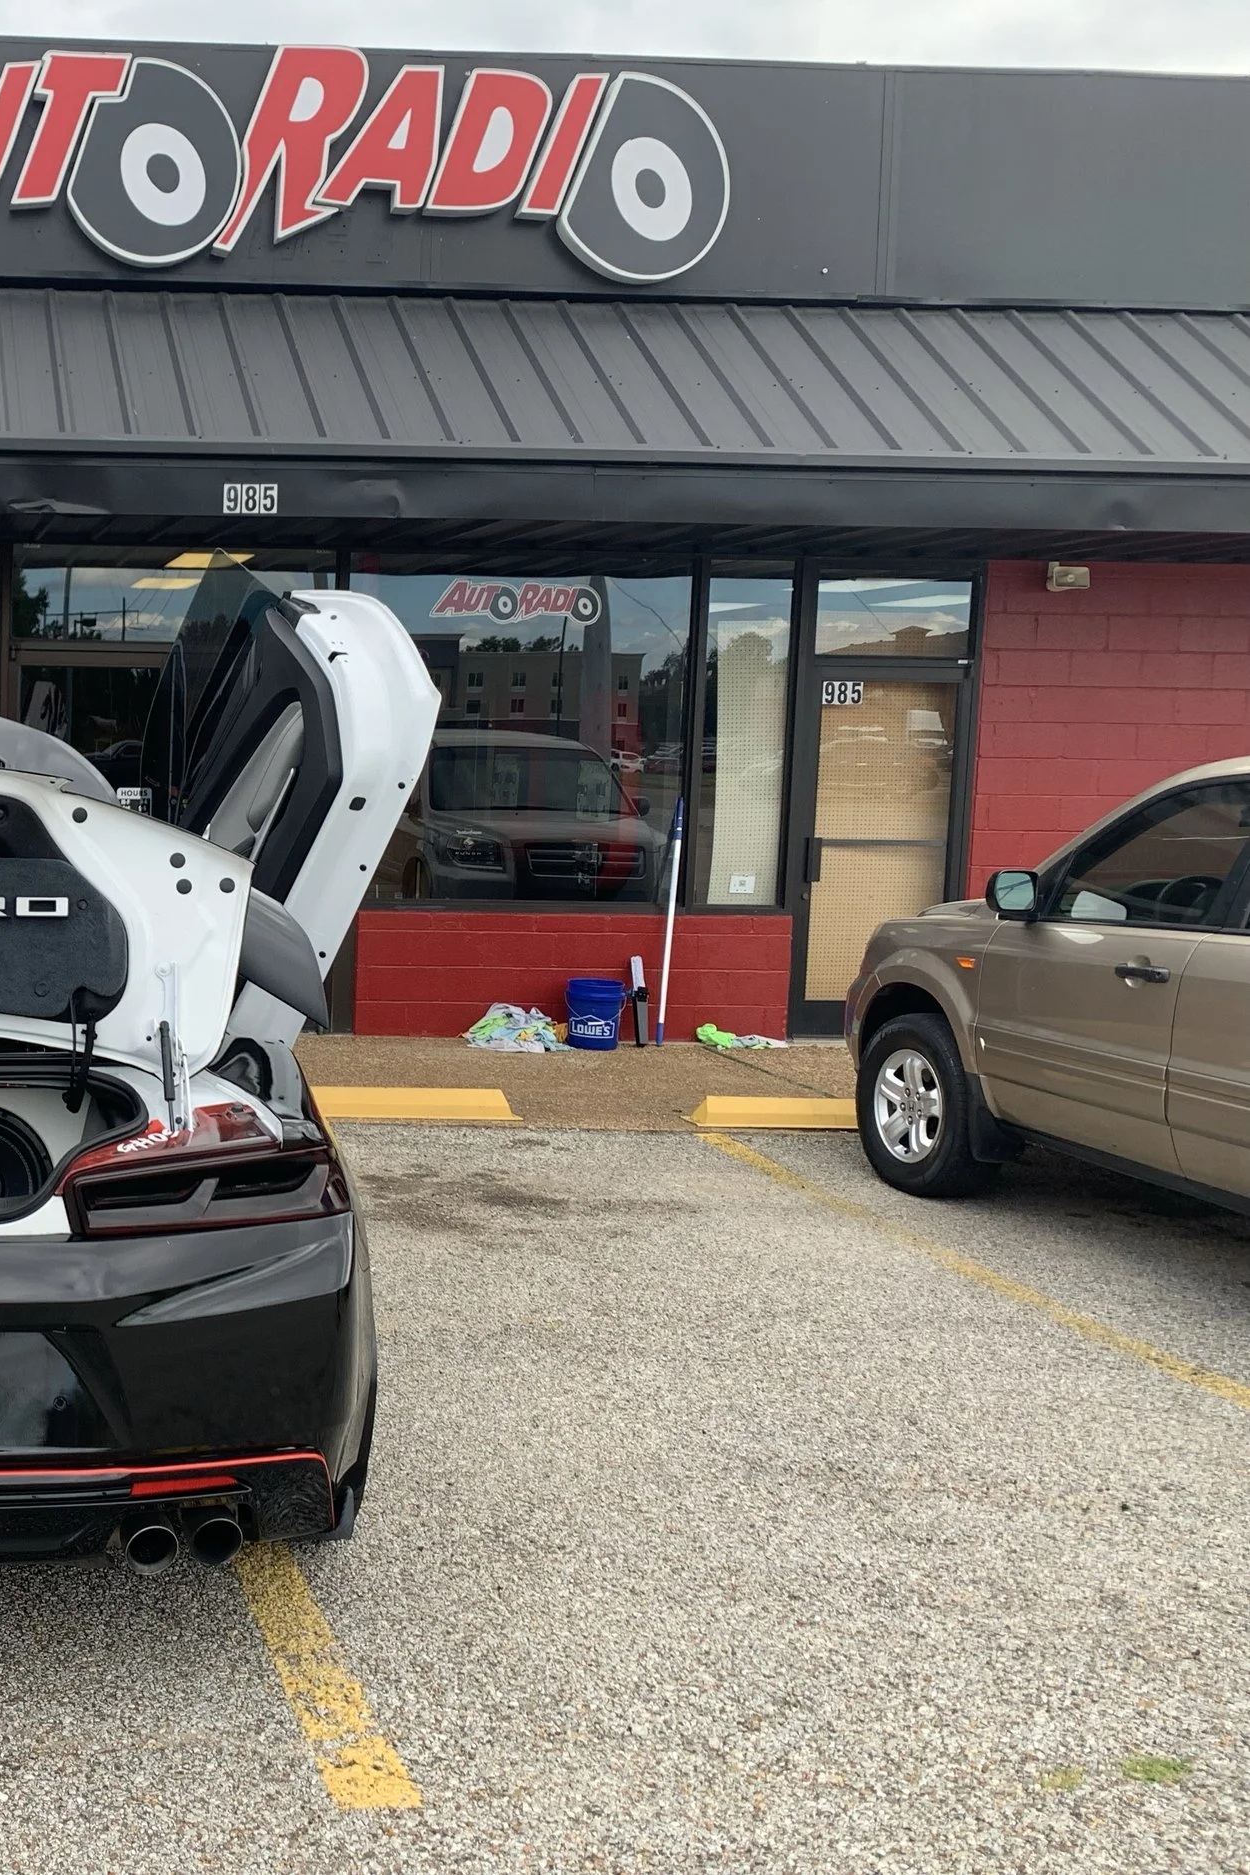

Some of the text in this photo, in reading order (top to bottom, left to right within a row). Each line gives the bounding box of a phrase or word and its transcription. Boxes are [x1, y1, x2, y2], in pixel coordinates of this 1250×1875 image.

[225, 484, 278, 513] 985
[824, 682, 862, 704] 985
[120, 789, 148, 797] HOURS
[571, 1021, 611, 1036] LOWE'S
